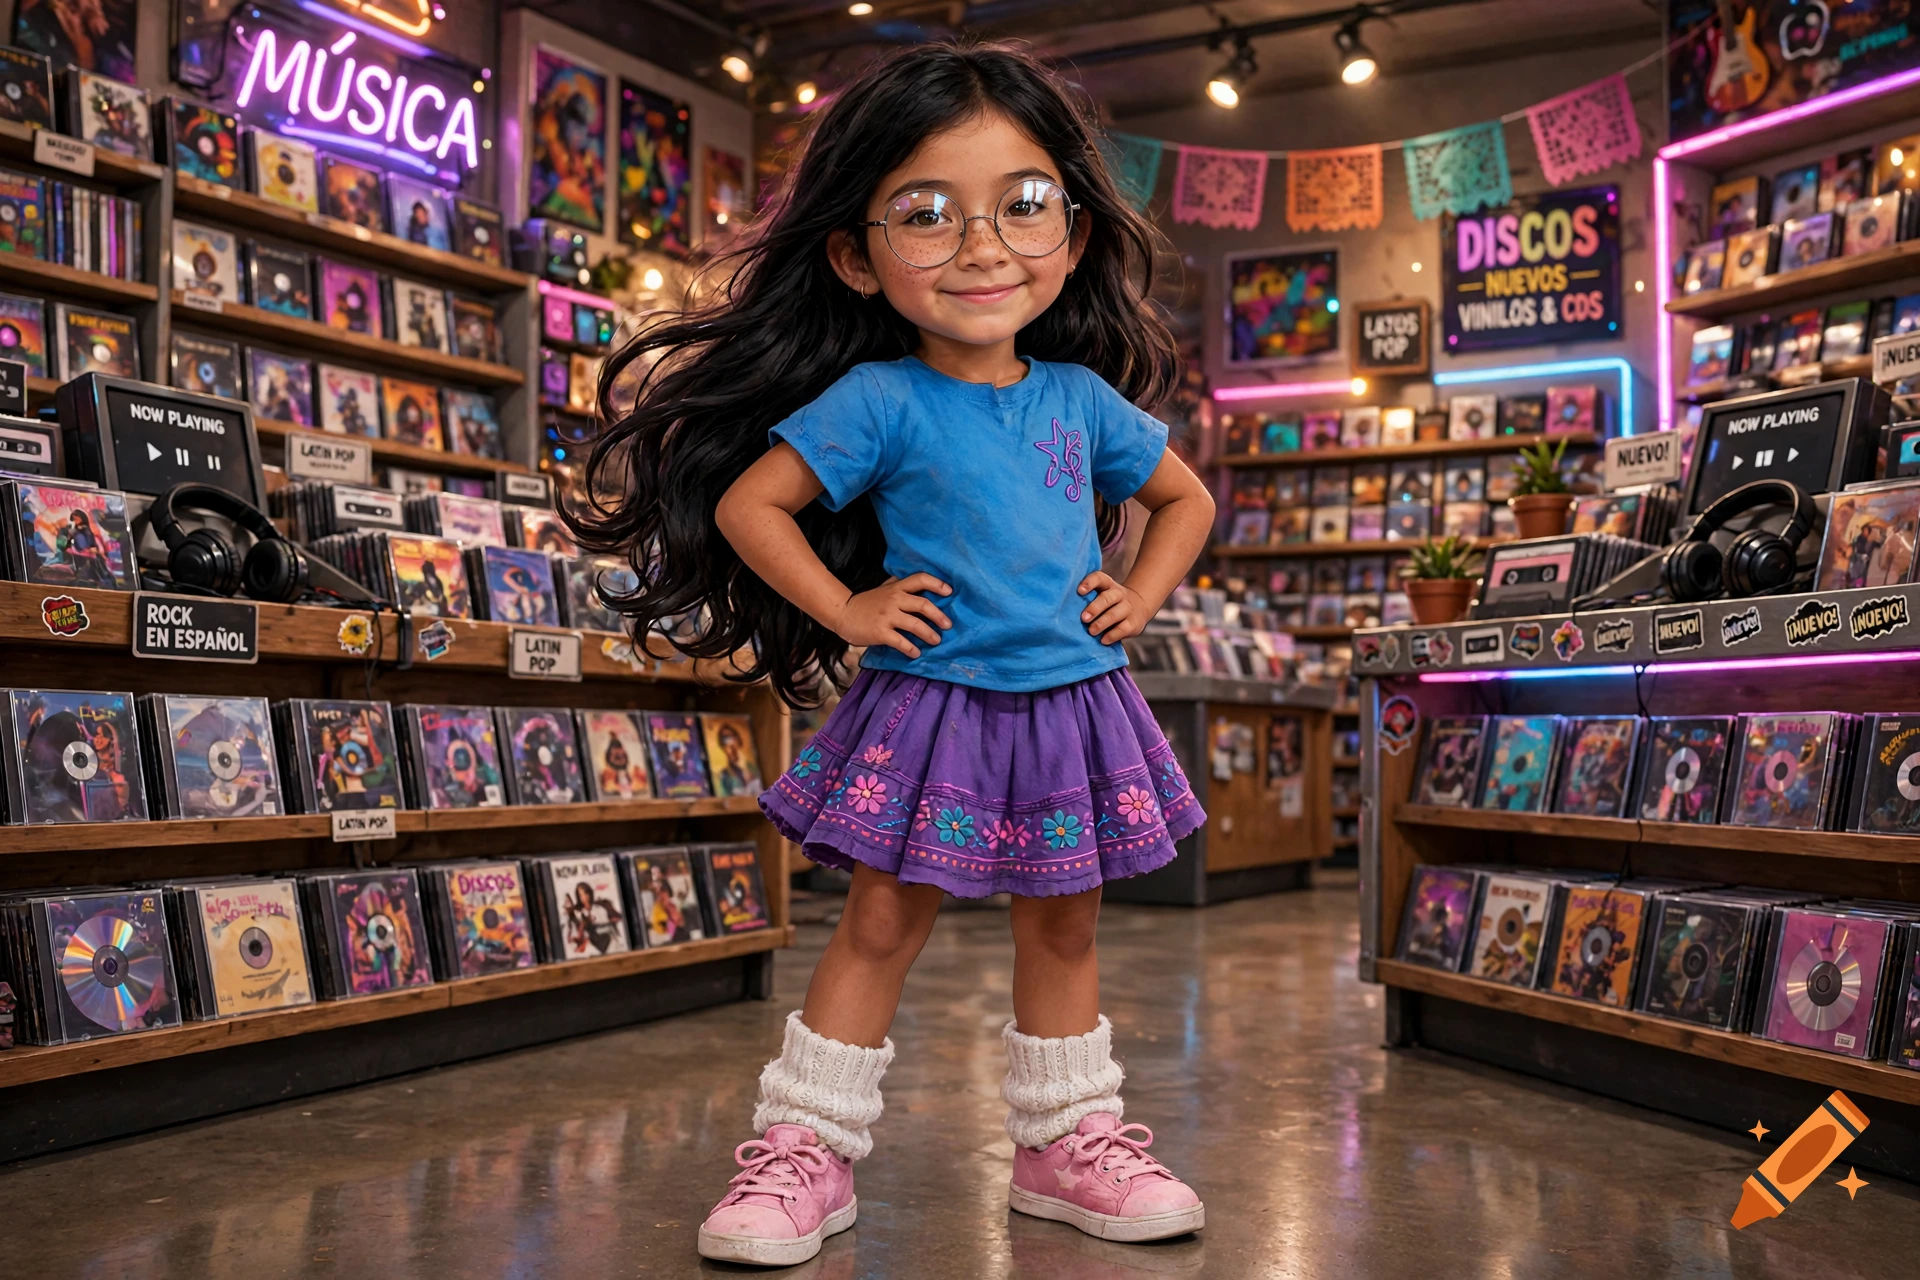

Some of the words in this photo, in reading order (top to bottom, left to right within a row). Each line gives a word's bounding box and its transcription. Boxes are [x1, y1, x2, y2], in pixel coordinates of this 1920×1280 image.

[236, 29, 478, 168] MÚSICA
[1457, 204, 1600, 272] DISCOS
[1485, 263, 1569, 298] NUEVOS
[1458, 297, 1538, 332] VINILOS
[1540, 296, 1558, 325] &
[130, 403, 164, 423] NOW
[168, 410, 225, 435] PLAYING
[1727, 416, 1761, 435] NOW
[1762, 407, 1819, 430] PLAYING
[335, 448, 355, 462] POP
[1617, 441, 1669, 467] NUEVO!
[147, 603, 193, 626] ROCK
[146, 627, 169, 648] EN
[174, 626, 248, 652] ESPAÑOL
[525, 638, 561, 655] LATIN
[530, 656, 556, 672] POP
